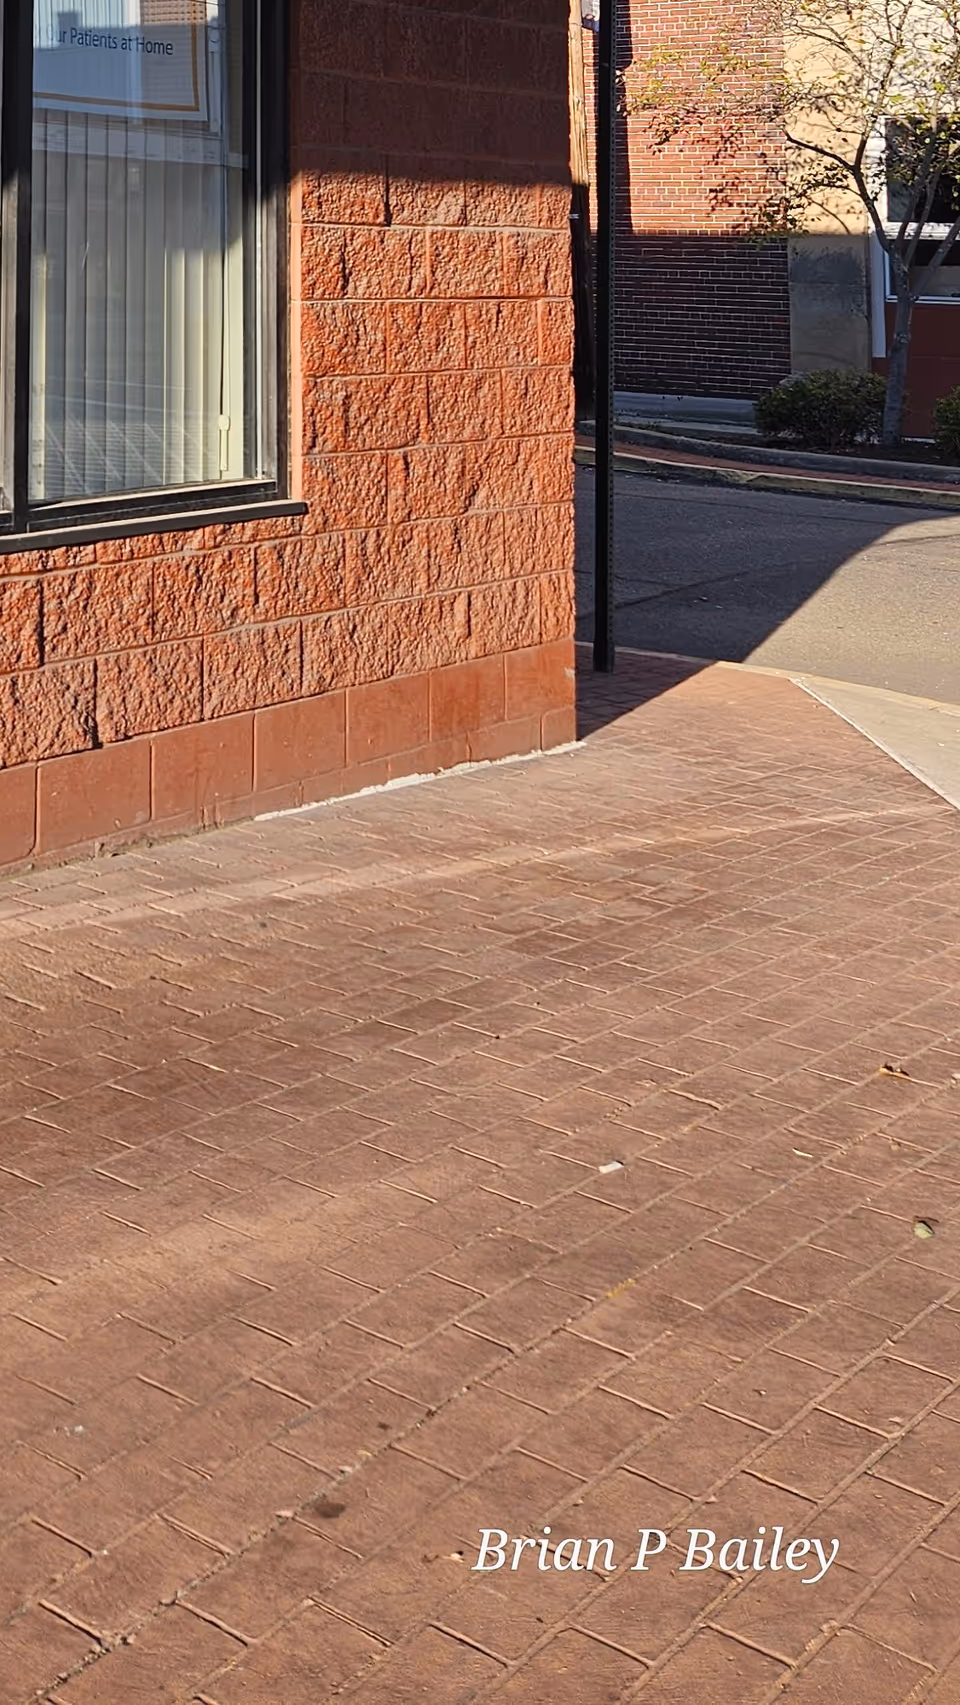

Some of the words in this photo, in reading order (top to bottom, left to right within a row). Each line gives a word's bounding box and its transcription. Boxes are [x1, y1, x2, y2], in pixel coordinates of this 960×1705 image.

[71, 27, 118, 50] Patients
[121, 36, 133, 51] at
[139, 36, 173, 55] Home
